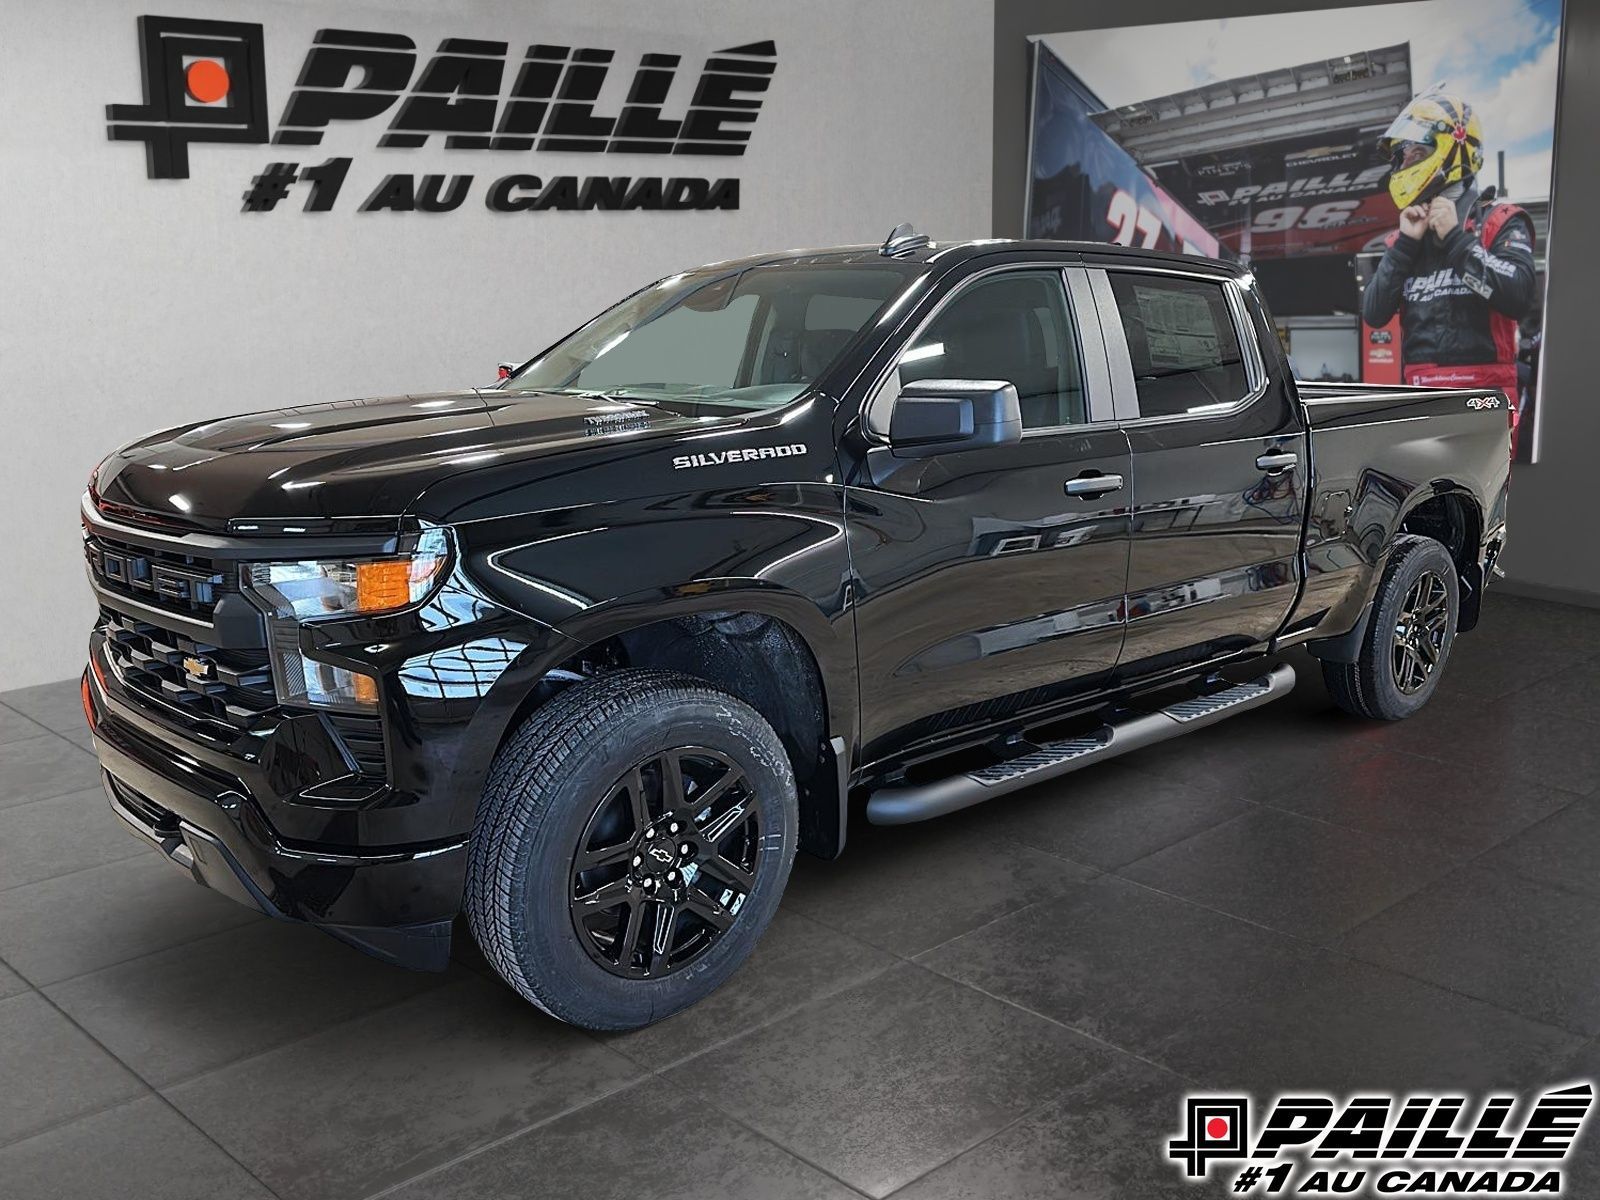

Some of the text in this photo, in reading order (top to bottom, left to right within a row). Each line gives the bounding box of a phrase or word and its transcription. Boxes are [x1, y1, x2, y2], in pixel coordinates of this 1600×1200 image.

[271, 29, 777, 155] PAILLÉ
[241, 157, 740, 212] #1 AU CANADA
[1251, 200, 1361, 233] 96
[673, 444, 807, 469] SILVERADO
